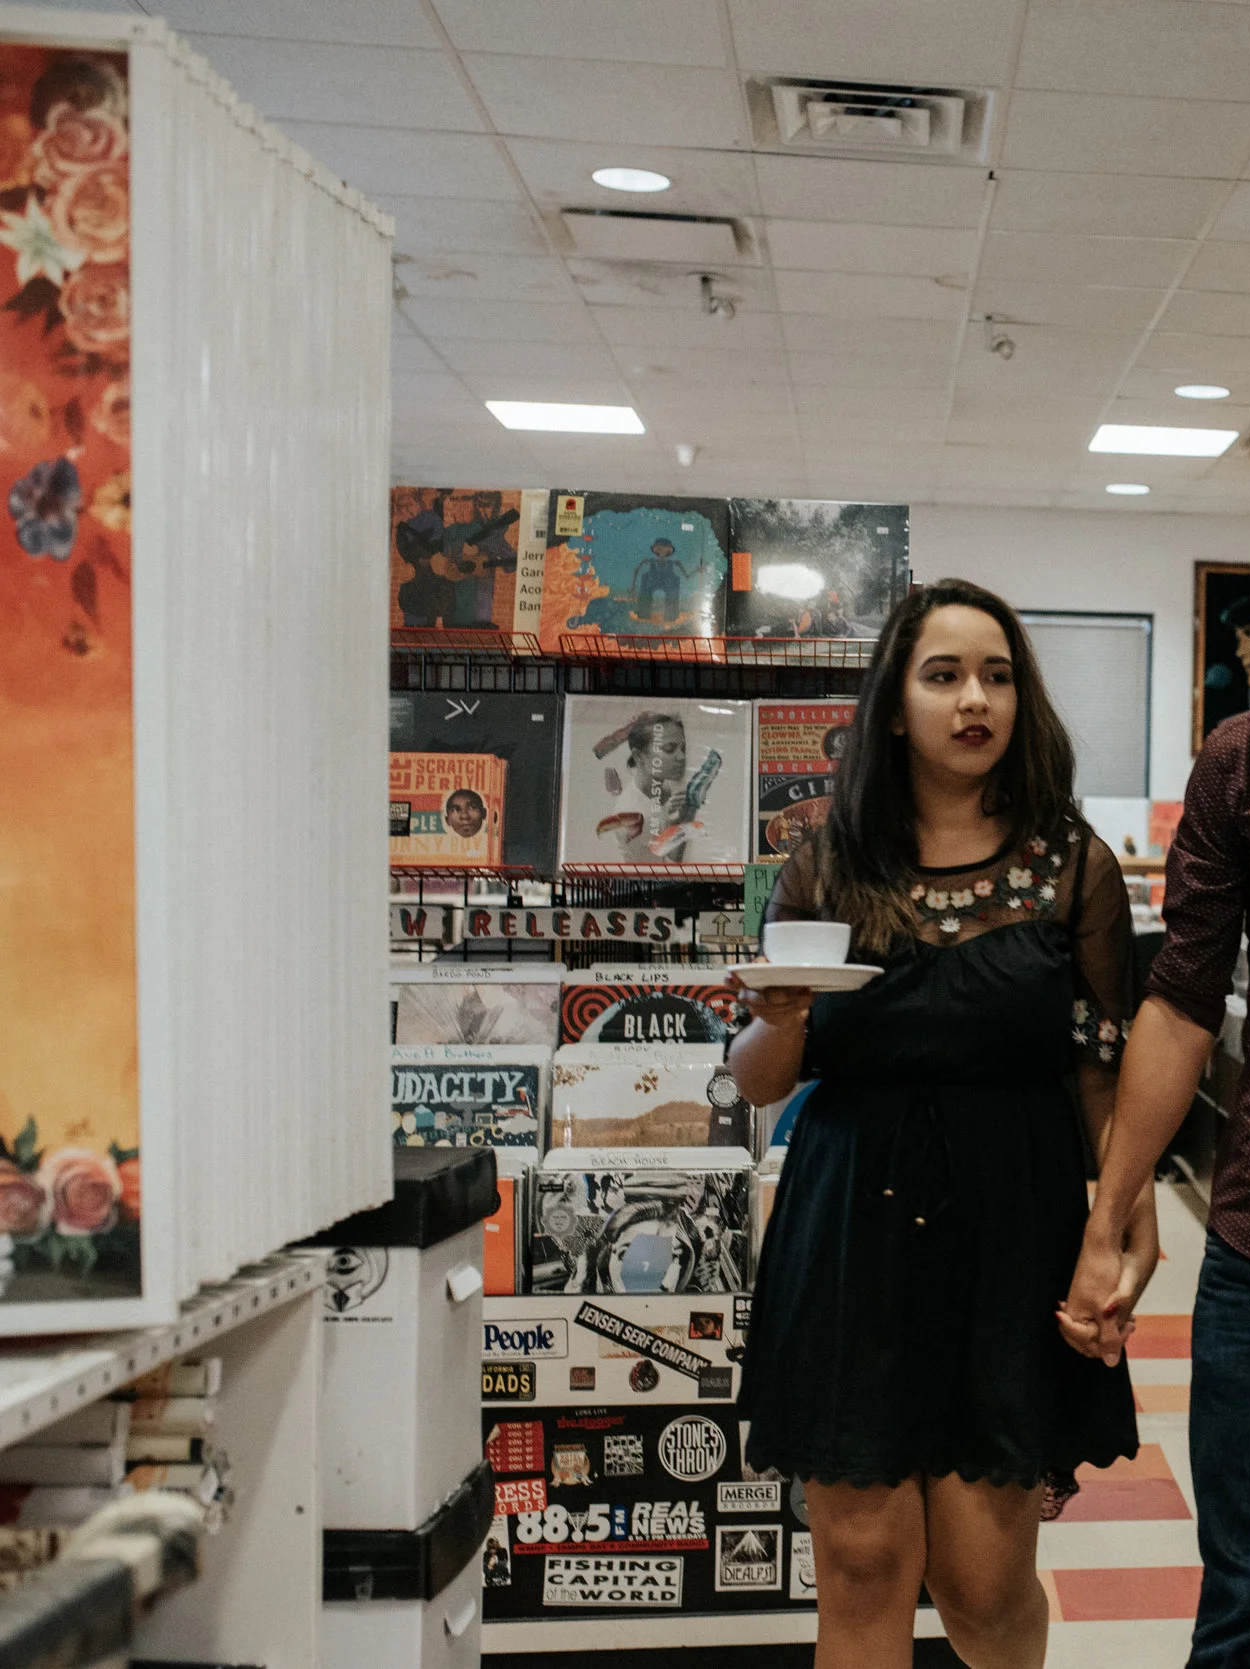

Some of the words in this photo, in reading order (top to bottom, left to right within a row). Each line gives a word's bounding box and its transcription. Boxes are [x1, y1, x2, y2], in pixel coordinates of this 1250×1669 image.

[520, 601, 541, 612] Ban
[777, 710, 850, 720] ROLLING
[653, 723, 664, 753] FIND
[652, 757, 663, 777] TO
[762, 764, 814, 773] ROCK
[467, 907, 673, 942] RELEASES
[595, 972, 635, 982] BLACK
[641, 972, 670, 982] LIPS
[624, 1013, 687, 1039] BLACK
[634, 1156, 669, 1166] HOUSE
[578, 1306, 625, 1337] JENSEN
[622, 1327, 655, 1351] SERF
[483, 1323, 555, 1355] People
[482, 1374, 531, 1394] DADS
[666, 1421, 719, 1449] STONES
[667, 1447, 718, 1474] THROW
[724, 1486, 773, 1500] MERGE
[631, 1500, 705, 1520] REAL
[614, 1509, 626, 1536] FM
[631, 1516, 706, 1537] NEWS
[547, 1559, 678, 1572] FISHING
[547, 1575, 677, 1587] CAPITAL
[546, 1588, 557, 1600] of
[560, 1588, 577, 1601] the
[580, 1589, 677, 1602] WORLD
